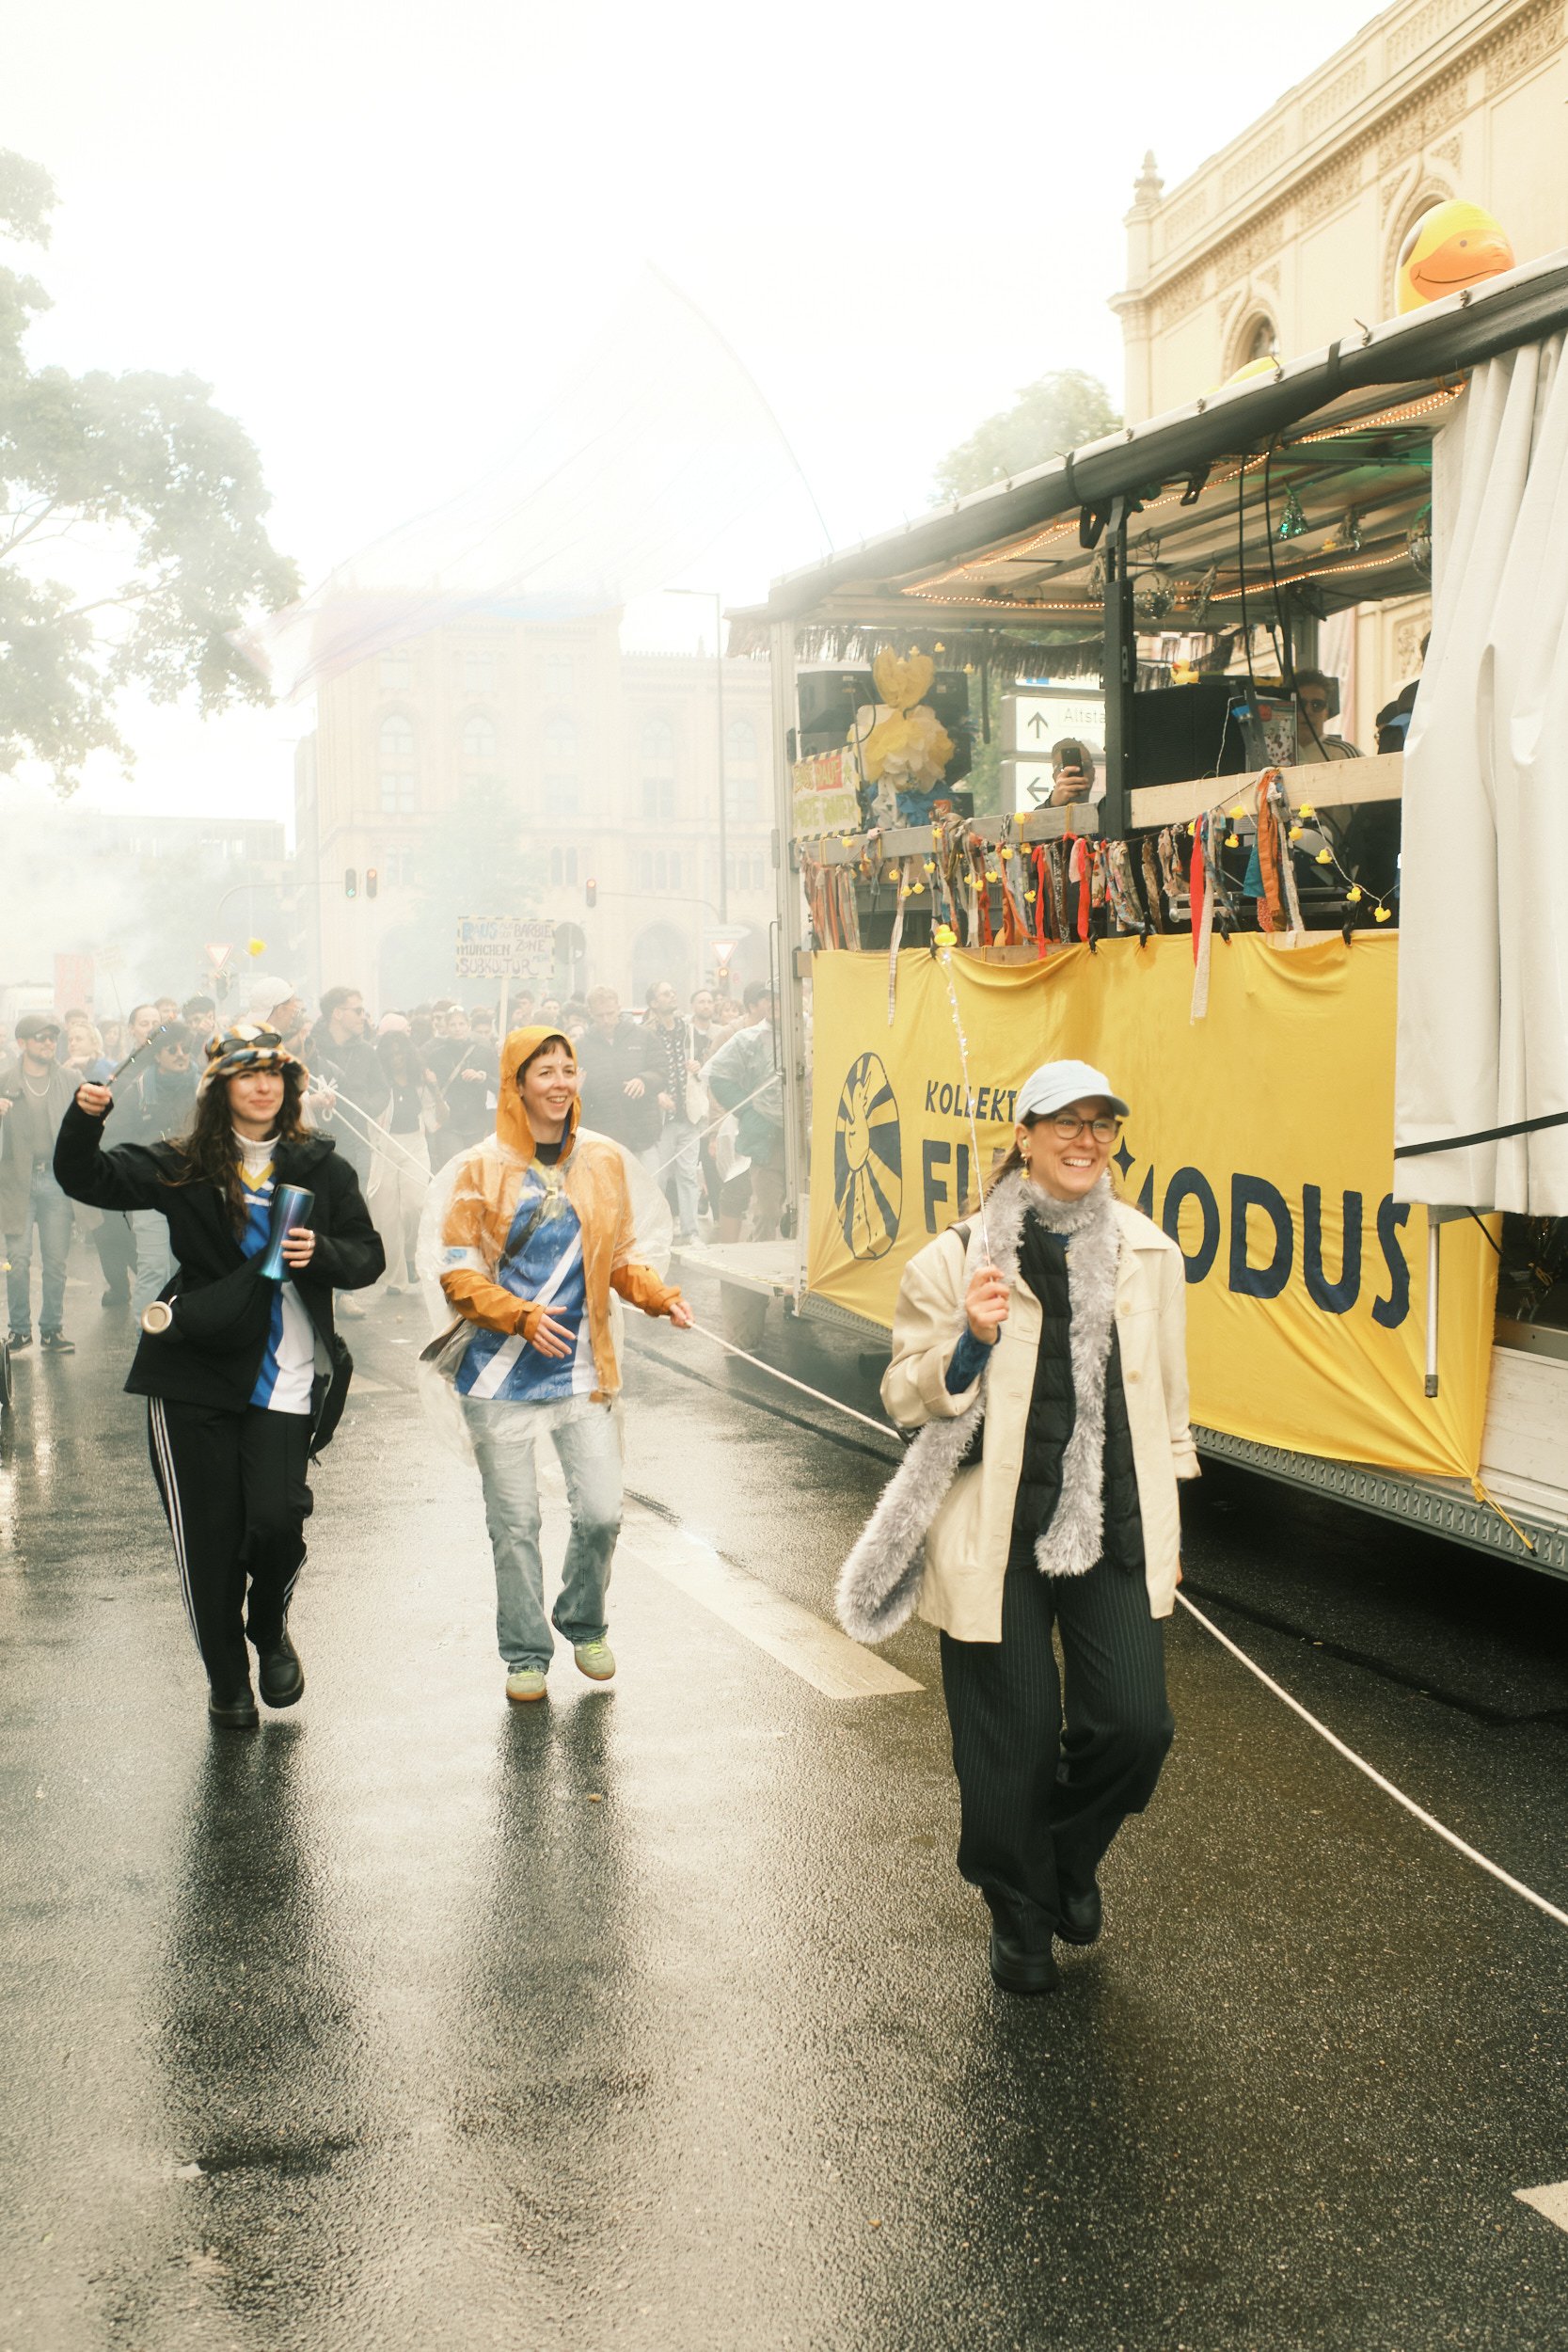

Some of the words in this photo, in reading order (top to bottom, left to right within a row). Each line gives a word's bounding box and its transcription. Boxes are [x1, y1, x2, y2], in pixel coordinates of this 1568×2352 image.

[1064, 707, 1105, 723] Altsta
[462, 921, 499, 943] RAUS
[514, 923, 552, 939] BARBIE
[515, 939, 546, 953] ZONE
[459, 958, 540, 977] SUBKULTUR
[925, 1080, 1018, 1122] KOLLEKT
